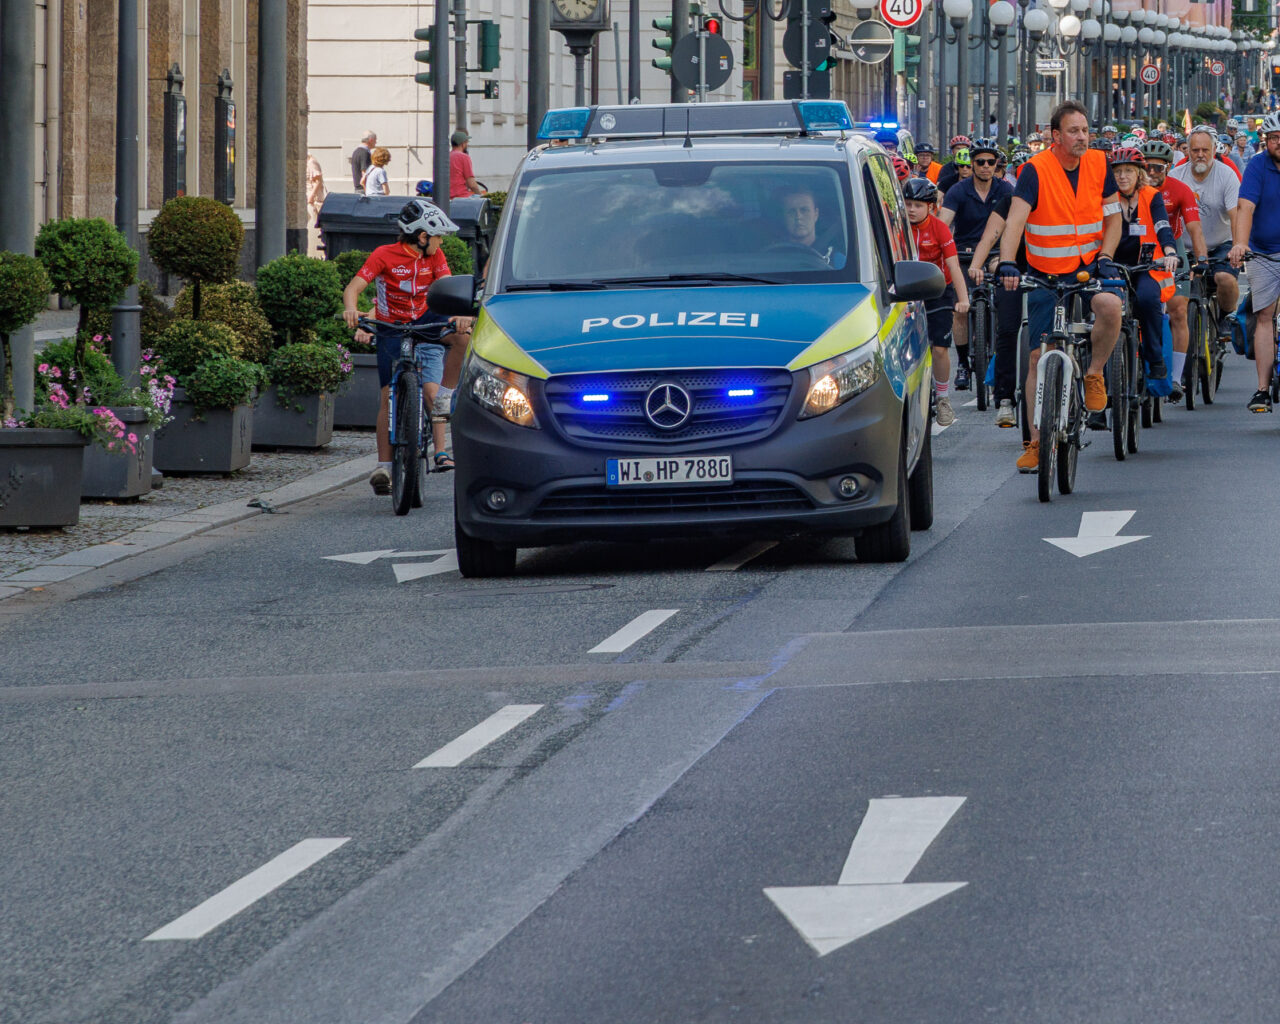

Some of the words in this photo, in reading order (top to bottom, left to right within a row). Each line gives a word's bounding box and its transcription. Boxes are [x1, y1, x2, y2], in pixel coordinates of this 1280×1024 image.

[1144, 70, 1156, 80] 40
[1213, 65, 1222, 73] 40
[582, 312, 760, 333] POLIZEI
[620, 462, 641, 481] WI
[656, 460, 679, 480] HP
[684, 459, 729, 479] 7880
